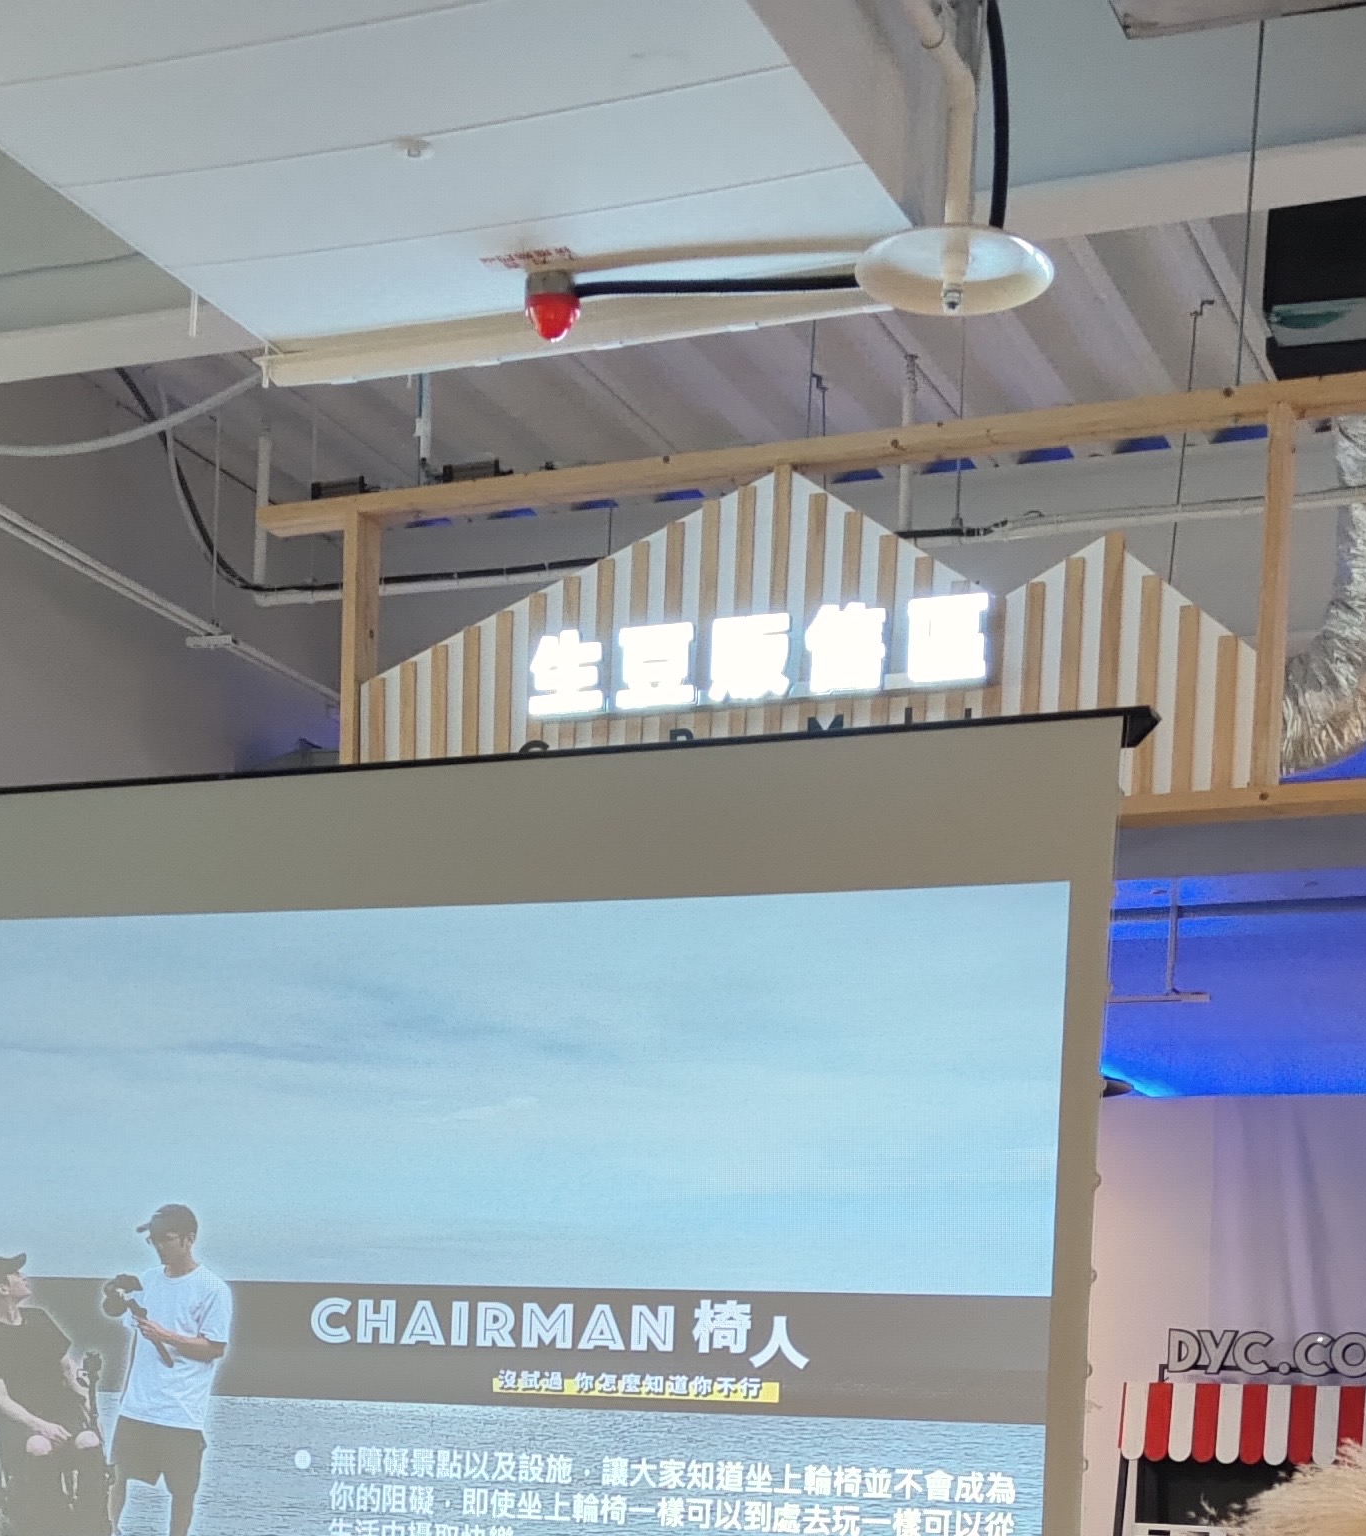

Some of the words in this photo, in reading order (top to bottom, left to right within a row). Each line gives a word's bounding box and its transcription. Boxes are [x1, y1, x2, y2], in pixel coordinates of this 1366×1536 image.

[310, 1297, 675, 1353] CHAIRMAN
[692, 1299, 810, 1370] 椅人
[497, 1368, 565, 1392] 沒試過
[574, 1371, 763, 1398] 你怎麼知道你不行
